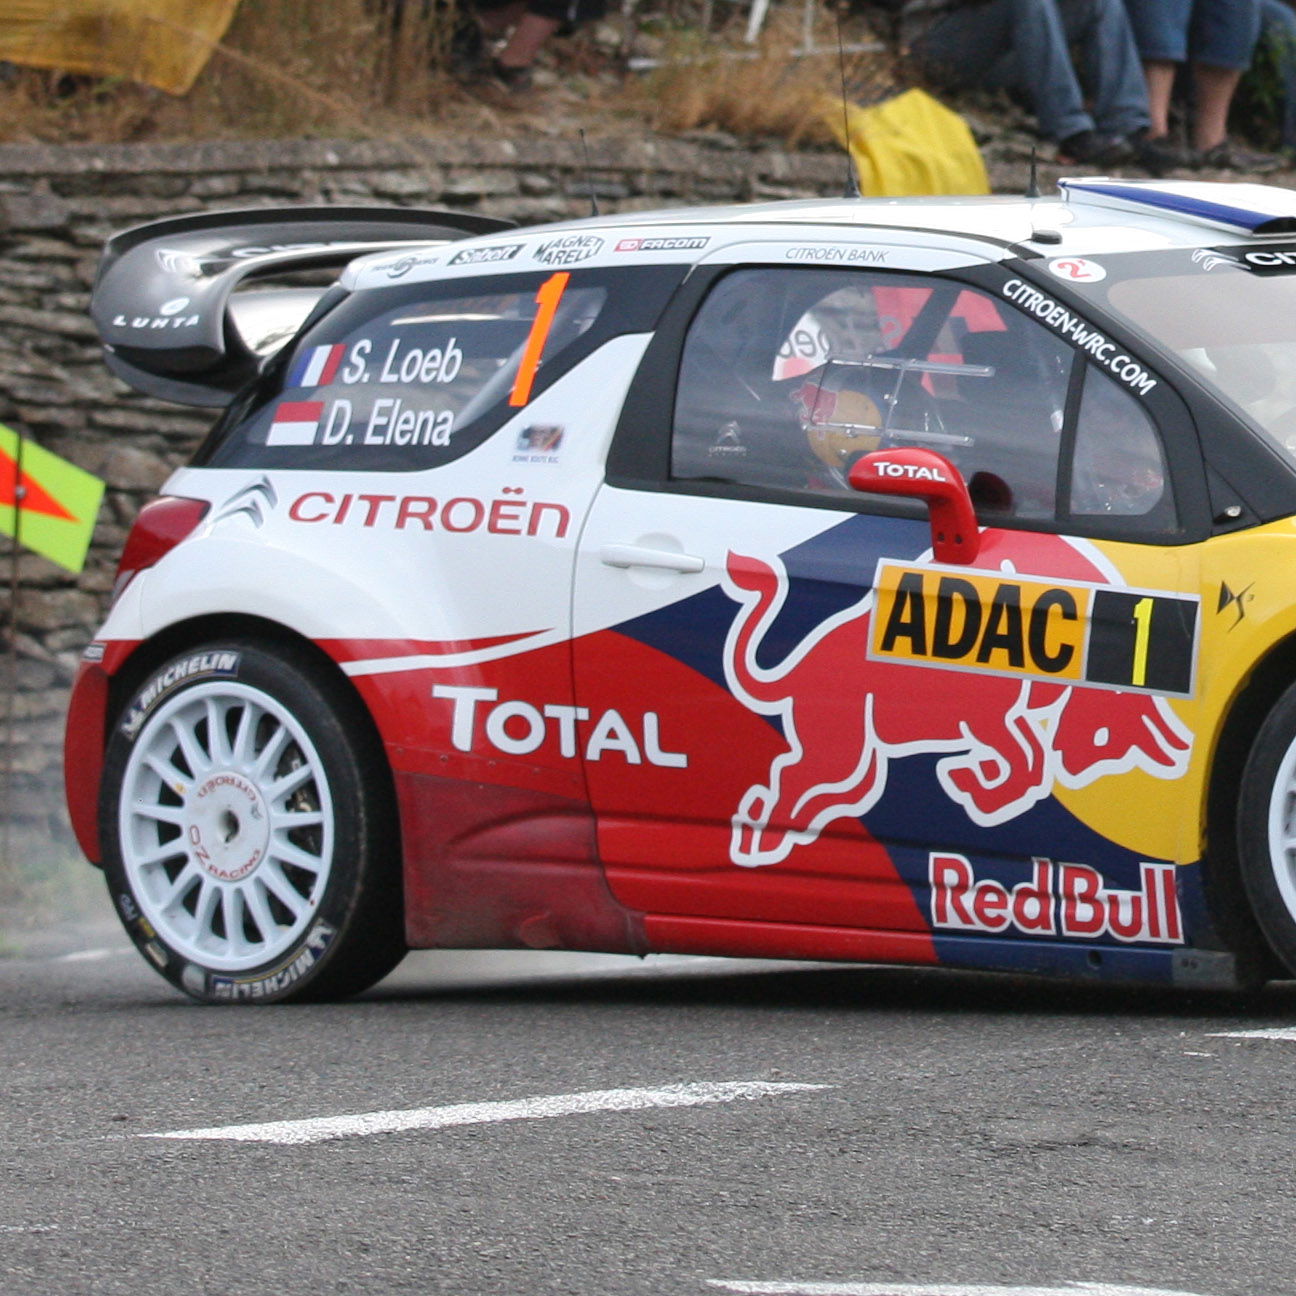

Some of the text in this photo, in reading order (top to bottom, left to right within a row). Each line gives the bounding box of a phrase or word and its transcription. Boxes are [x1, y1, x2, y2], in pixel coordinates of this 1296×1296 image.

[848, 249, 888, 263] BANK
[113, 314, 199, 328] LUHTA
[509, 273, 571, 407] 1
[1002, 279, 1156, 395] CITROEN-WRC.COM
[342, 337, 462, 384] S. Loeb
[322, 398, 454, 446] D. Elena
[874, 461, 946, 482] TOTAL
[289, 487, 571, 538] CITROËN
[880, 572, 1155, 687] ADAC 1
[141, 653, 237, 710] MICHELIN
[432, 686, 688, 767] TOTAL
